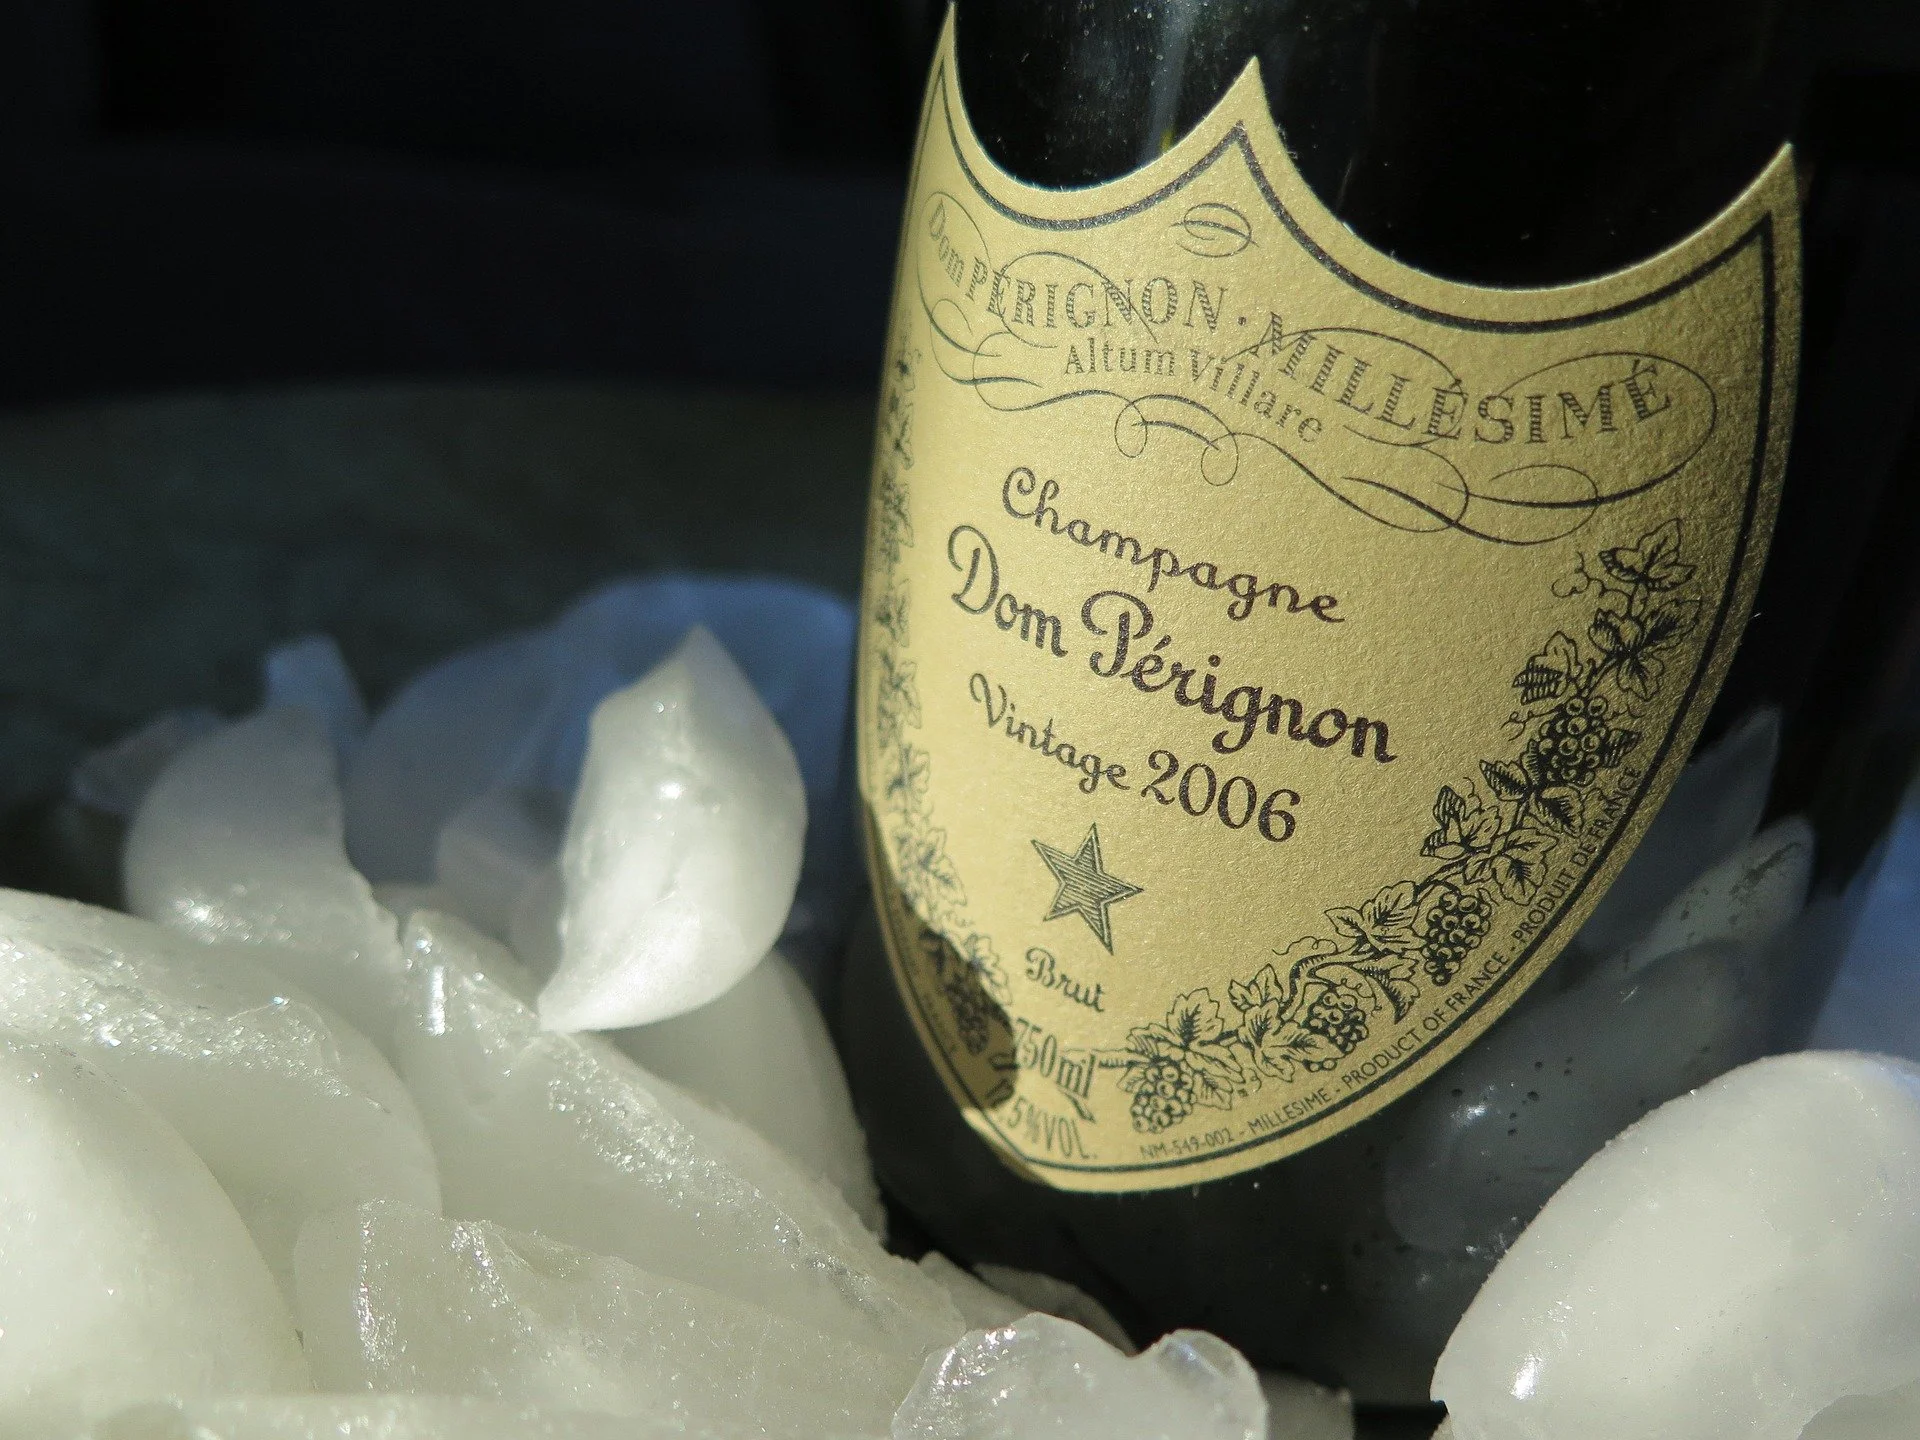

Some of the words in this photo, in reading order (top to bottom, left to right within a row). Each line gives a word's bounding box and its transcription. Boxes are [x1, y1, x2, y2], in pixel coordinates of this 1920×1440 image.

[1064, 337, 1176, 376] Altum
[1190, 348, 1322, 442] Villare
[1002, 467, 1345, 623] Champagne
[948, 525, 1068, 658] Dom
[1082, 590, 1397, 763] Pérignon
[970, 672, 1131, 794] Vintage
[1141, 749, 1301, 843] 2006
[1026, 948, 1105, 1012] Brut
[1247, 1088, 1331, 1135] MILLESIME
[1342, 1028, 1423, 1089] PRODUCT
[1422, 1008, 1447, 1032] OF
[1445, 952, 1510, 1013] FRANCE
[1511, 868, 1576, 944] PRODUIT
[1570, 841, 1598, 867] DE
[1588, 766, 1641, 839] FRANCE
